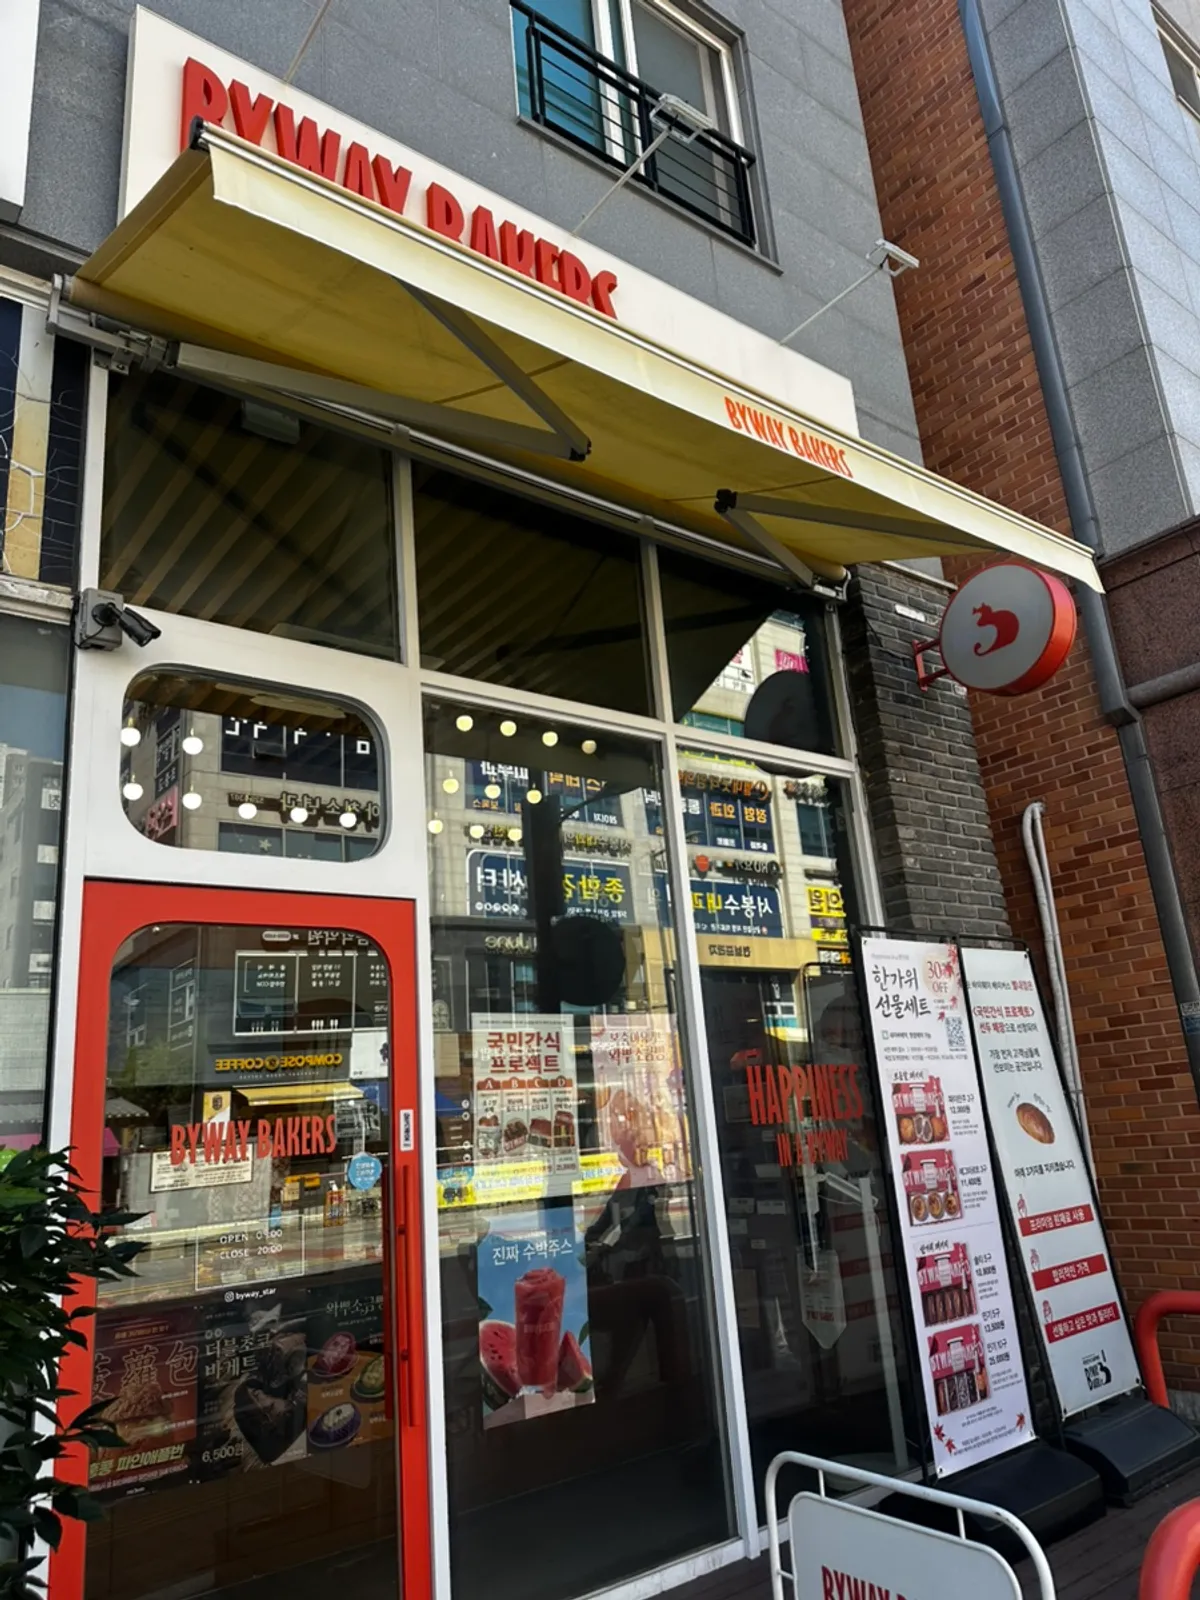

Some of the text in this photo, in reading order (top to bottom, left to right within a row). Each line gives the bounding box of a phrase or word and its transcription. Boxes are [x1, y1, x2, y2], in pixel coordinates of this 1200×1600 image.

[725, 397, 853, 478] BYWAY BAKERS
[871, 965, 918, 991] 한가위
[932, 982, 948, 993] OFF
[875, 994, 931, 1019] 선물세트
[486, 1031, 560, 1052] 국민간식
[490, 1055, 560, 1075] 프로젝트
[485, 1081, 494, 1090] A
[511, 1079, 519, 1088] B
[557, 1078, 566, 1087] D
[746, 1064, 864, 1126] HAPPINESS
[170, 1114, 337, 1166] BYWAY BAKERS
[776, 1132, 792, 1167] IN
[219, 1232, 249, 1245] OPEN
[219, 1247, 250, 1260] CLOSE
[493, 1238, 574, 1266] 진짜 수박주스
[204, 1331, 272, 1358] 더블초코
[204, 1354, 260, 1379] 바게트
[821, 1566, 890, 1600] BYW
